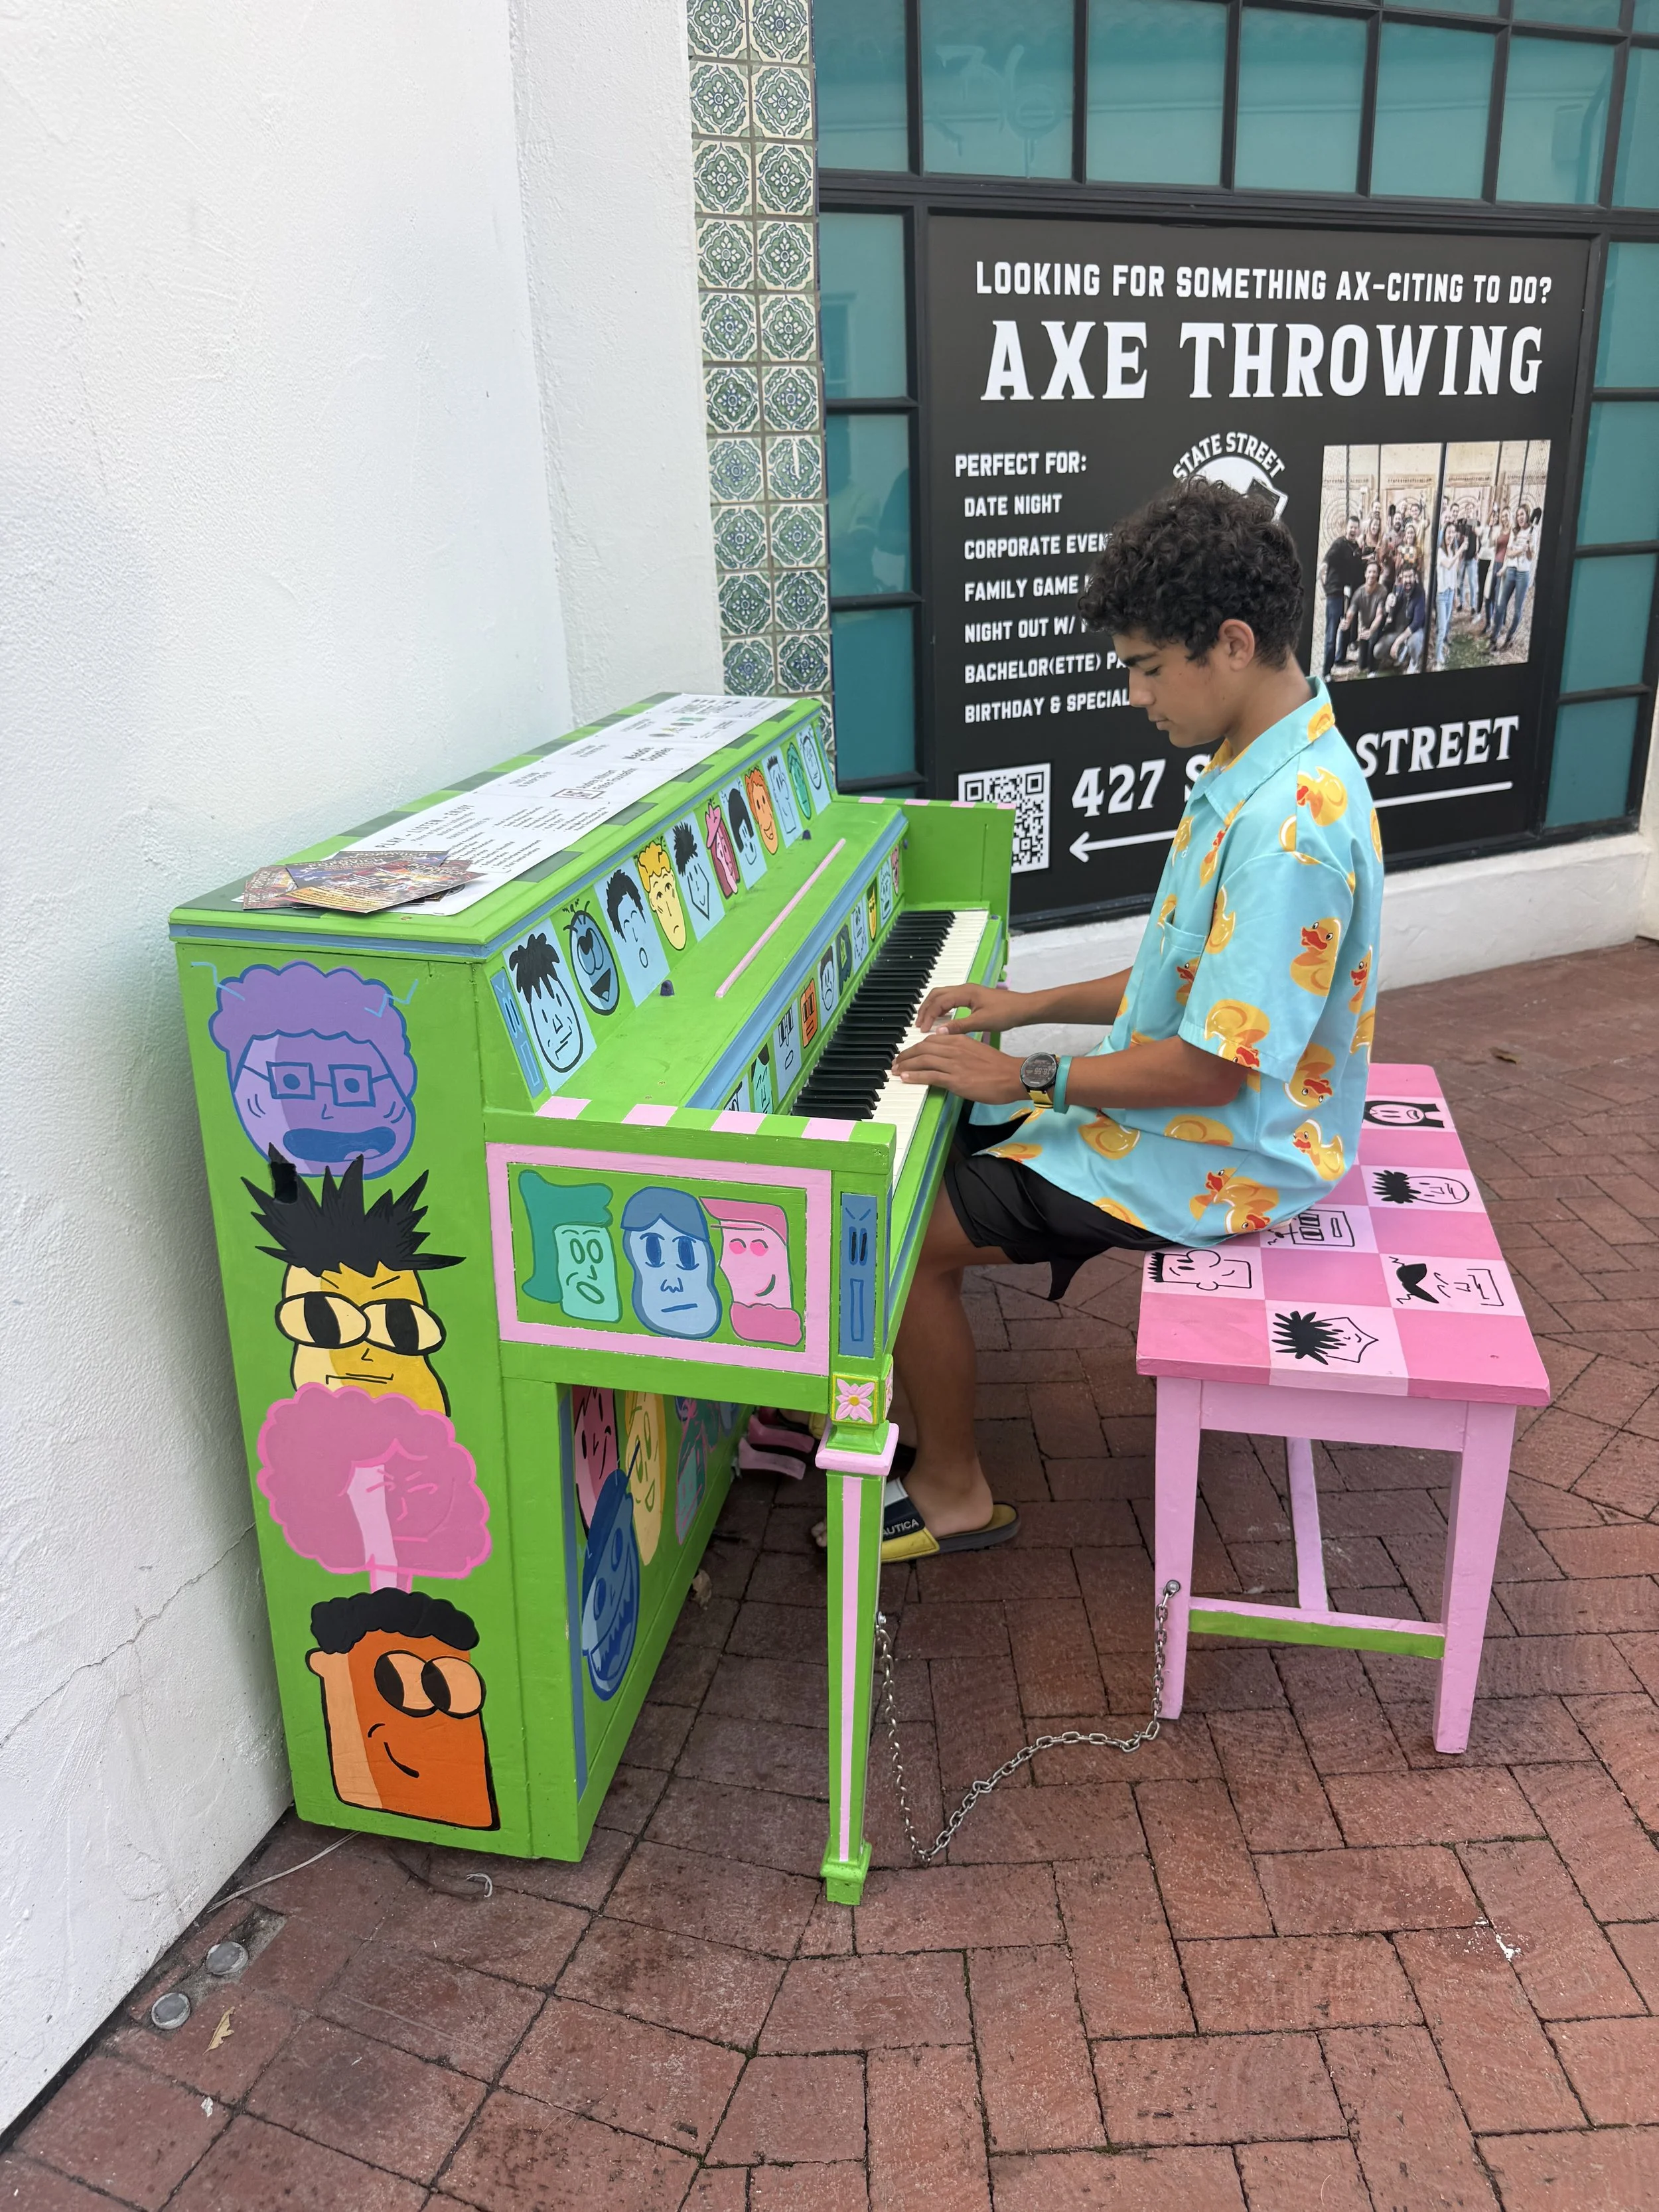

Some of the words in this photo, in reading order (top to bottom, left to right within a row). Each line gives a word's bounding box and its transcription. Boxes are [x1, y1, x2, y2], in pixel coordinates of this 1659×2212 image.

[976, 261, 1100, 296] LOOKING
[1112, 264, 1165, 297] FOR
[1176, 266, 1327, 300] SOMETHING
[1335, 271, 1464, 303] AX-CITING
[1473, 274, 1500, 303] TO
[1508, 275, 1552, 304] DO?
[980, 320, 1148, 401] AXE
[1179, 322, 1543, 398] THROWING
[955, 452, 1040, 477] PERFECT
[1045, 451, 1087, 475] FOR:
[1173, 433, 1222, 479] STATE
[1226, 431, 1285, 479] STREET
[964, 496, 1008, 518] DATE
[1014, 493, 1062, 515] NIGHT
[964, 536, 1060, 560] CORPORATE
[964, 579, 1025, 602] FAMILY
[1033, 575, 1079, 597] GAME
[965, 621, 1013, 643] NIGHT
[1018, 618, 1049, 638] OUT
[1054, 615, 1076, 635] W/
[965, 653, 1101, 684] BACHELOR(ETTE)
[965, 698, 1045, 723] BIRTHDAY
[1050, 696, 1062, 713] &
[1066, 688, 1130, 712] SPECIAL
[1072, 759, 1166, 817] 427
[1355, 715, 1519, 778] STREET
[375, 838, 405, 848] PLAY
[407, 820, 444, 833] LISTEN
[407, 863, 467, 876] POPOVICH
